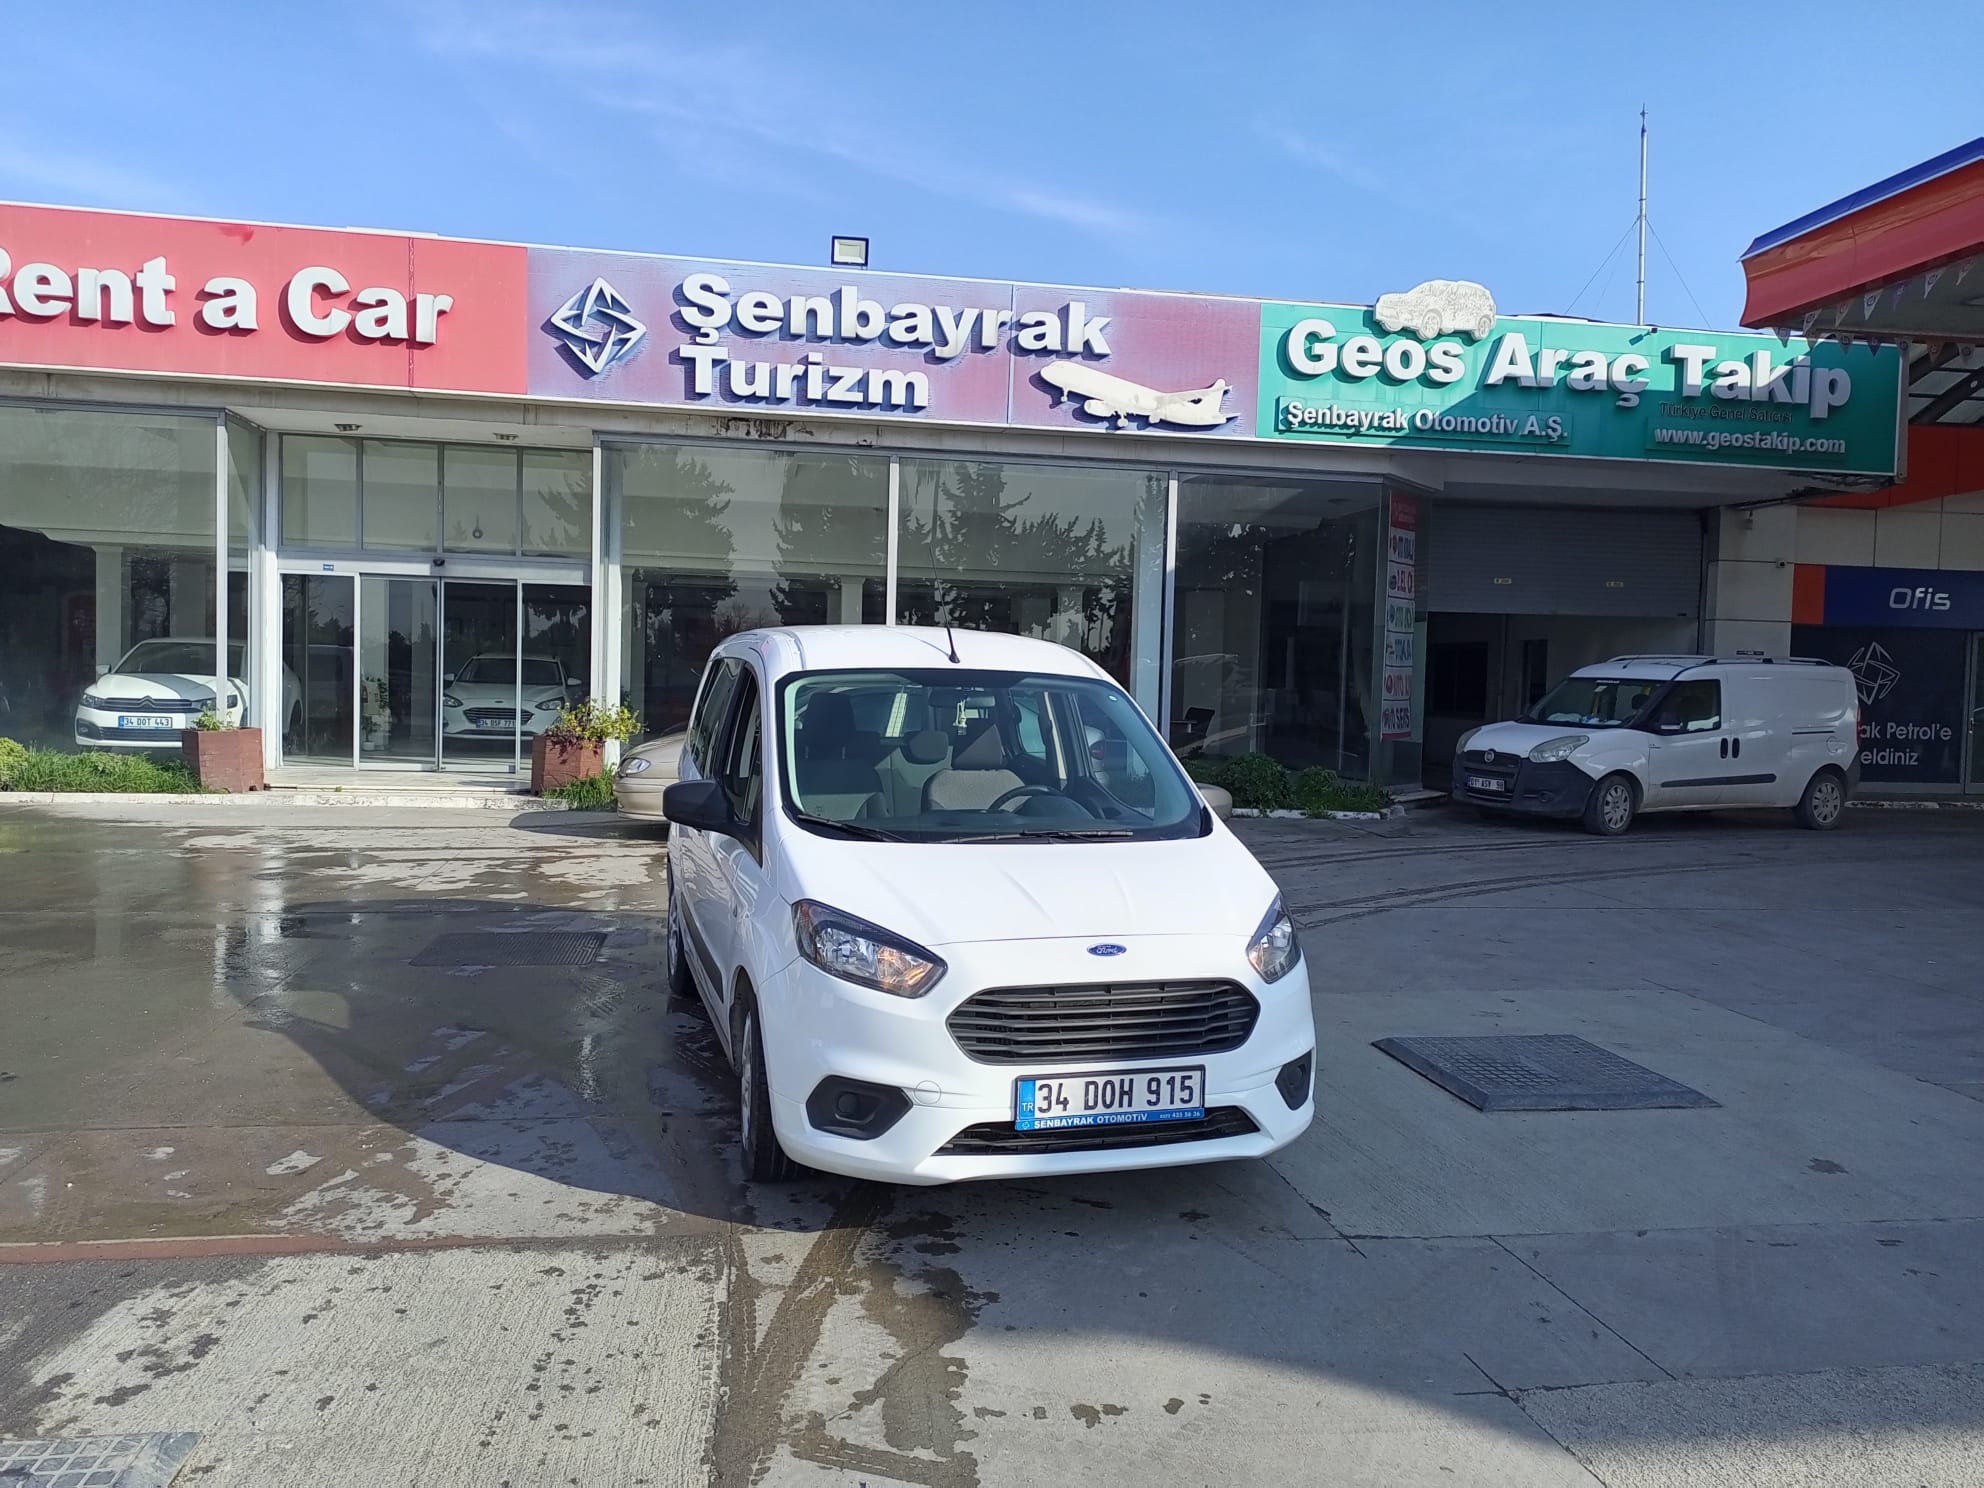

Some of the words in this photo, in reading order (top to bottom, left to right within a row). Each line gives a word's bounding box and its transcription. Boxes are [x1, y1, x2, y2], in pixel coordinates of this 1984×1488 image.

[201, 276, 258, 330] a
[288, 266, 454, 344] Car
[680, 273, 1111, 358] Şenbayrak
[681, 344, 930, 408] Turizm
[1287, 318, 1466, 384] Geos
[1488, 332, 1651, 408] Araç
[1670, 343, 1851, 419] Takip
[1287, 401, 1409, 431] Şenbayrak
[1414, 408, 1519, 434] Otomotiv
[1522, 416, 1568, 441] A.Ş.
[1709, 405, 1745, 422] Genel
[1654, 428, 1846, 454] www.geostakip.com
[1889, 587, 1951, 610] Ofis
[1886, 722, 1952, 741] Petrol'e
[1860, 748, 1919, 765] eldiniz
[1022, 1102, 1033, 1112] TR
[1037, 1082, 1069, 1113] 34
[1084, 1078, 1134, 1111] DOH
[1146, 1074, 1194, 1107] 915
